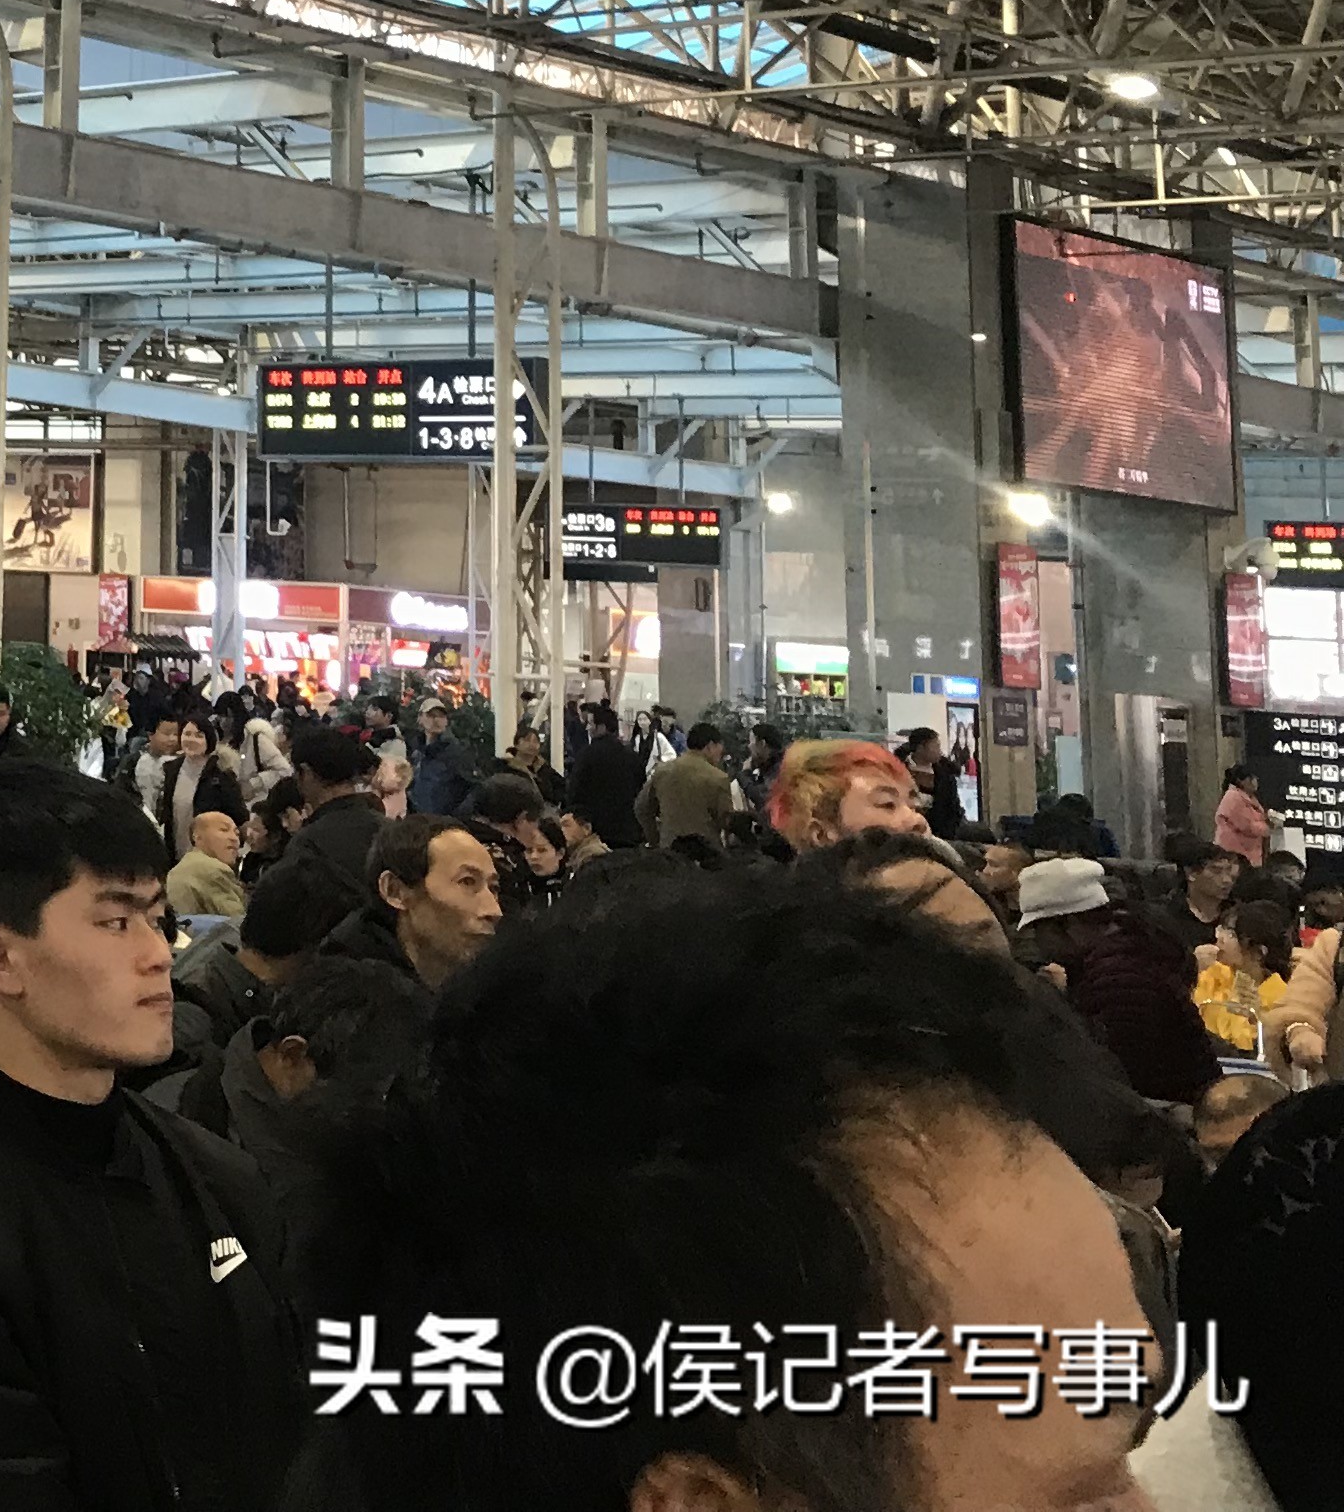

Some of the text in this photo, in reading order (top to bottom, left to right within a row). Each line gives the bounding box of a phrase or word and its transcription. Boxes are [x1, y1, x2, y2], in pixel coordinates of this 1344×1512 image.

[417, 376, 454, 405] 4A
[1273, 717, 1291, 731] 3A
[1273, 740, 1292, 754] 4A
[210, 1236, 243, 1262] NIK
